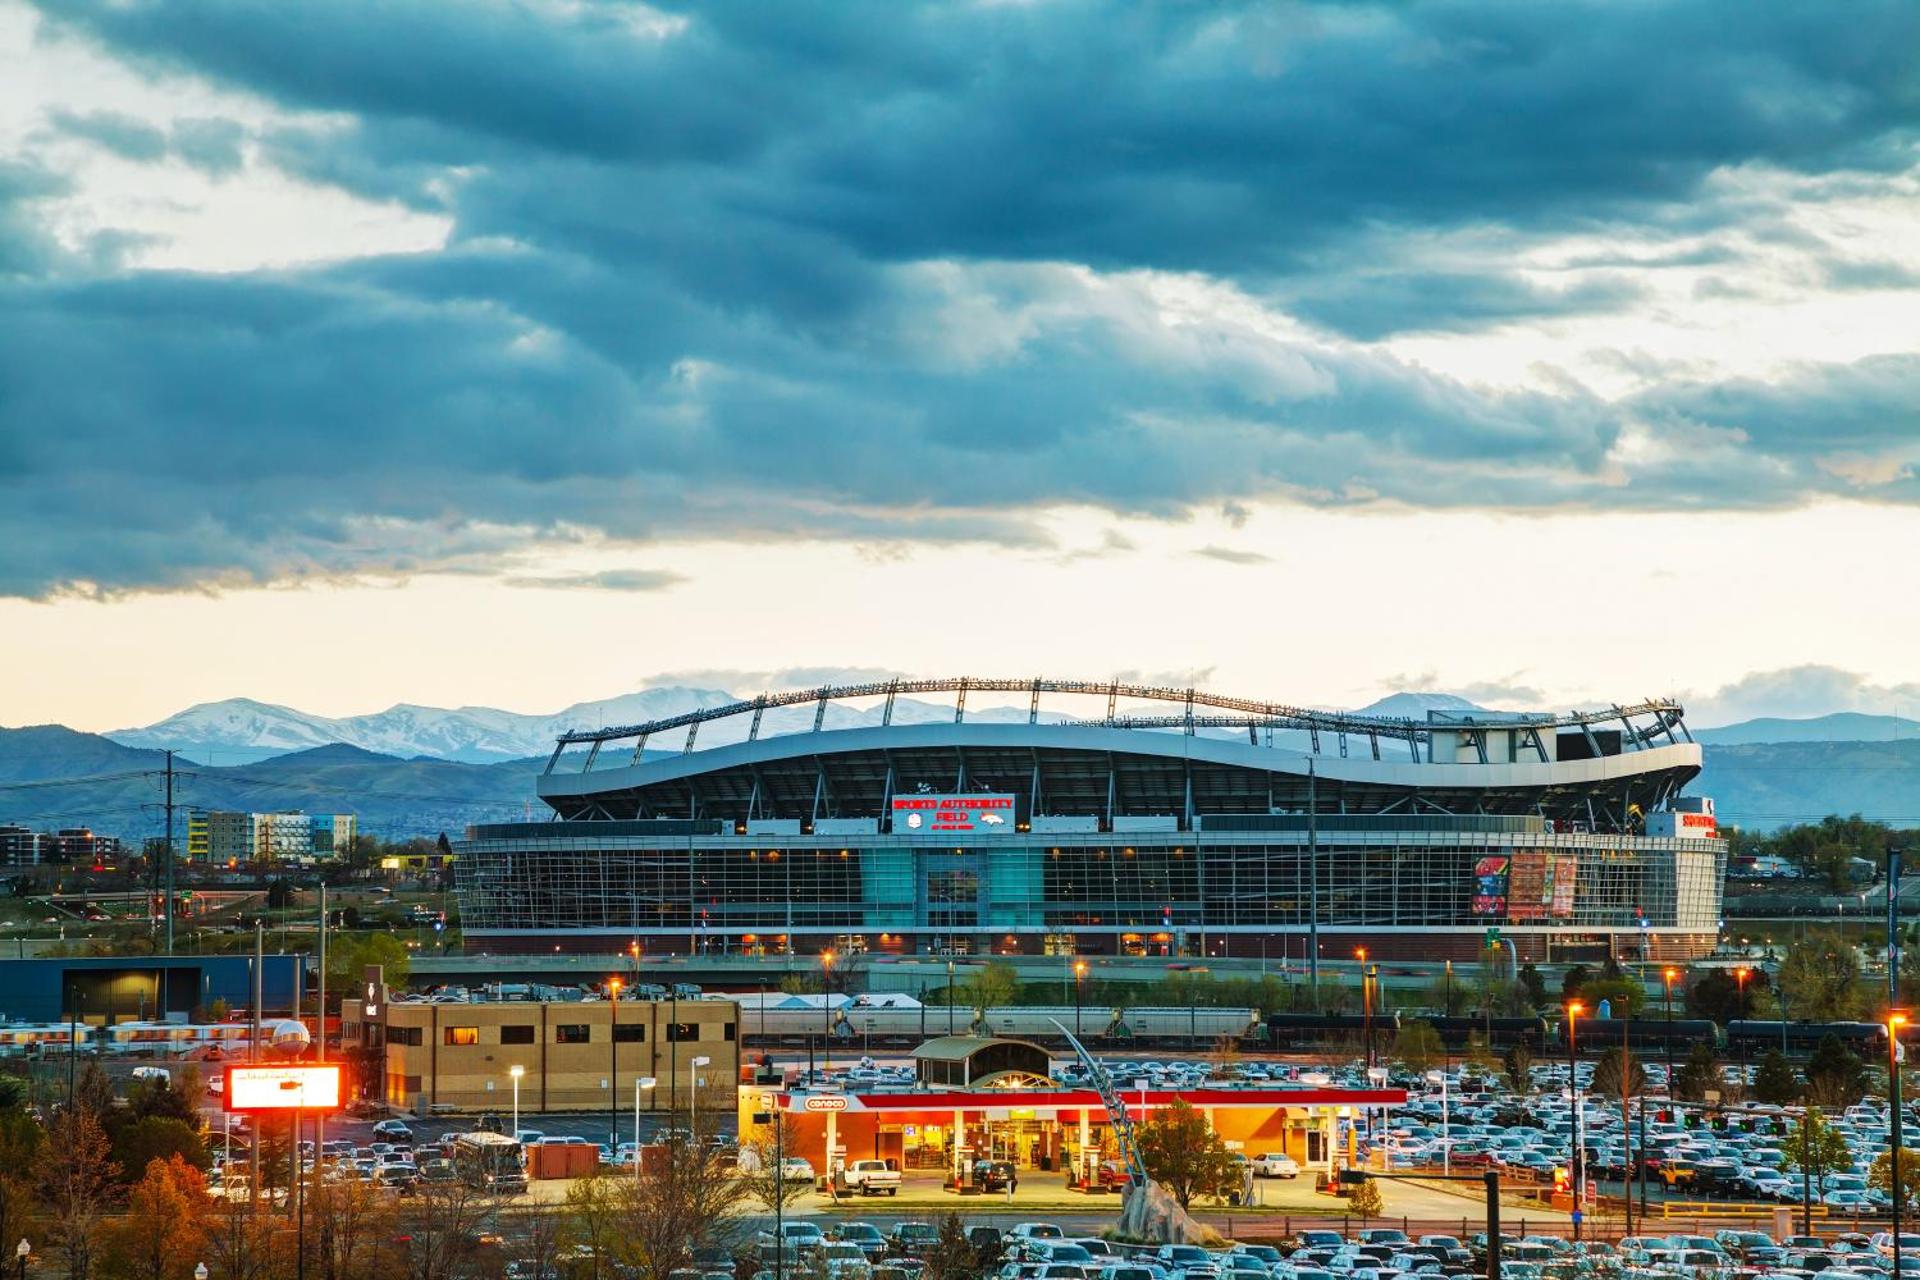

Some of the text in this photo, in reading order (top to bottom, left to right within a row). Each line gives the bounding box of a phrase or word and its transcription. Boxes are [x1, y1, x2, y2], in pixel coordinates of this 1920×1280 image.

[893, 799, 1012, 809] SPORTS AUTHORITY
[936, 812, 968, 822] FIELD
